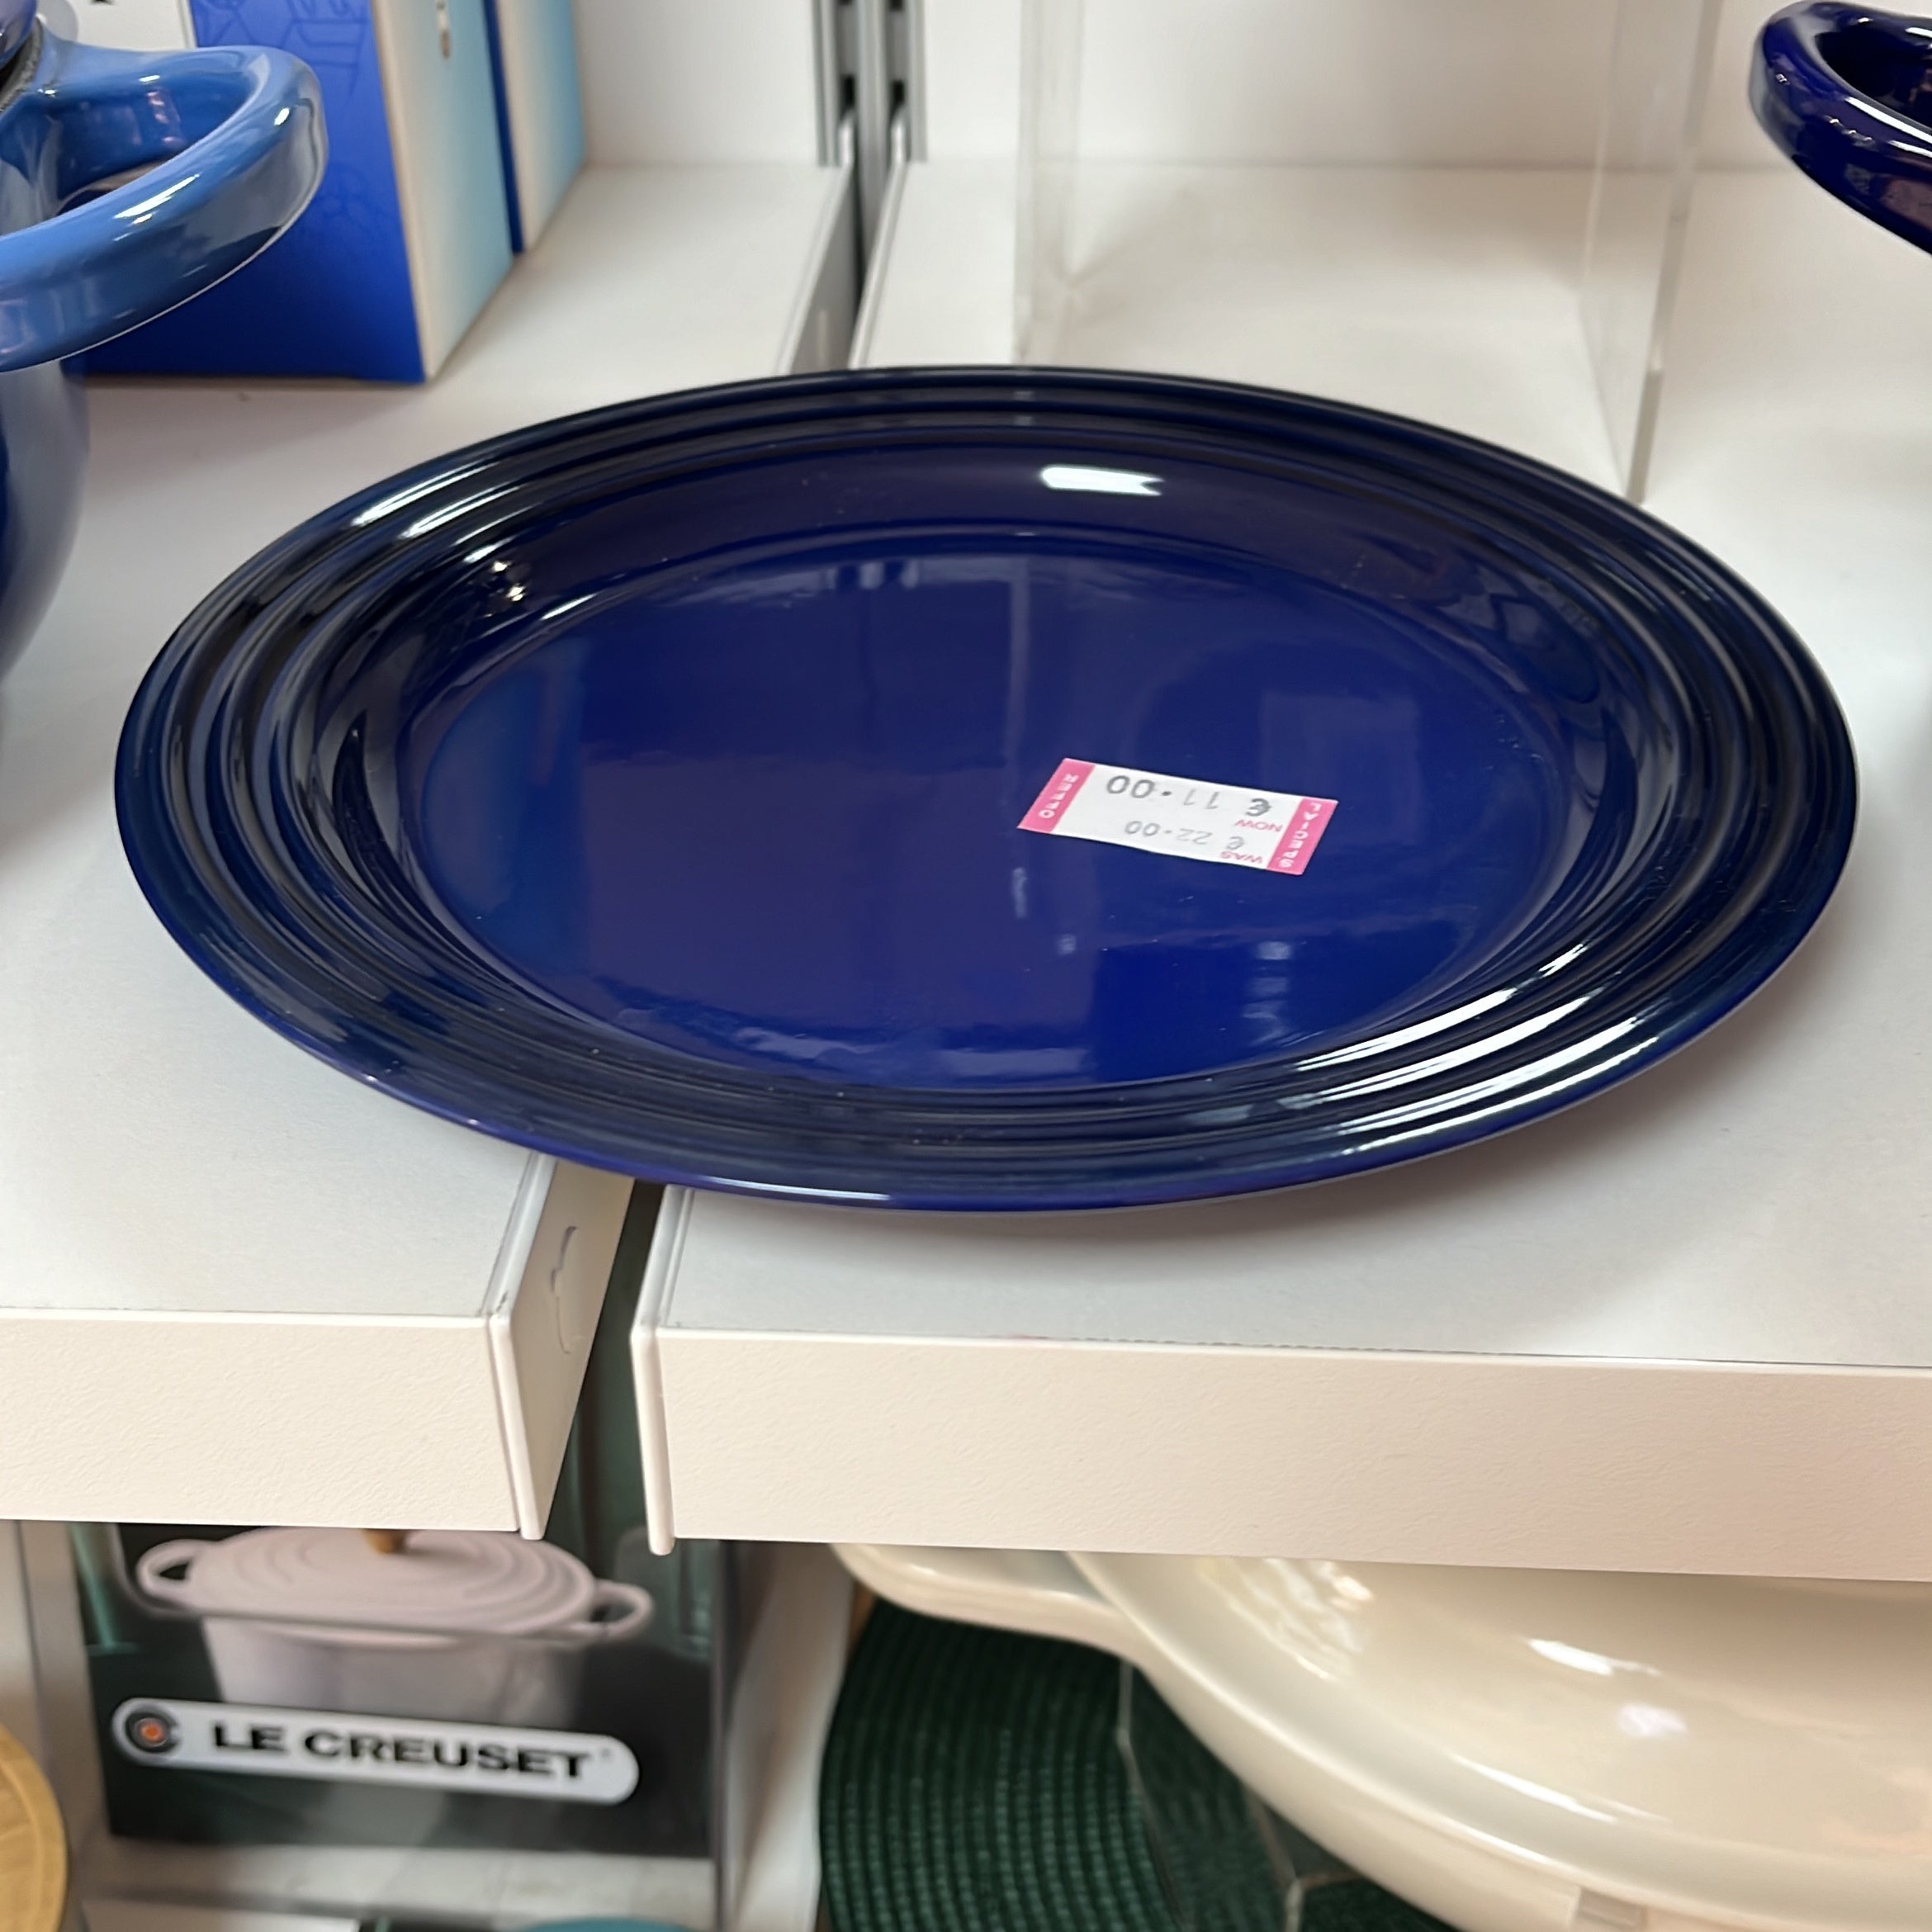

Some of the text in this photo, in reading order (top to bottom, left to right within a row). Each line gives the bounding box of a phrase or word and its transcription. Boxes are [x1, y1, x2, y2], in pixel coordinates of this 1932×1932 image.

[1038, 774, 1078, 819] OFFER
[1246, 798, 1272, 817] €
[1234, 819, 1283, 832] NOW
[1225, 836, 1245, 850] €
[1279, 803, 1321, 869] SPECIAL
[1220, 850, 1263, 864] WAS
[213, 1722, 590, 1778] LE CREUSET
